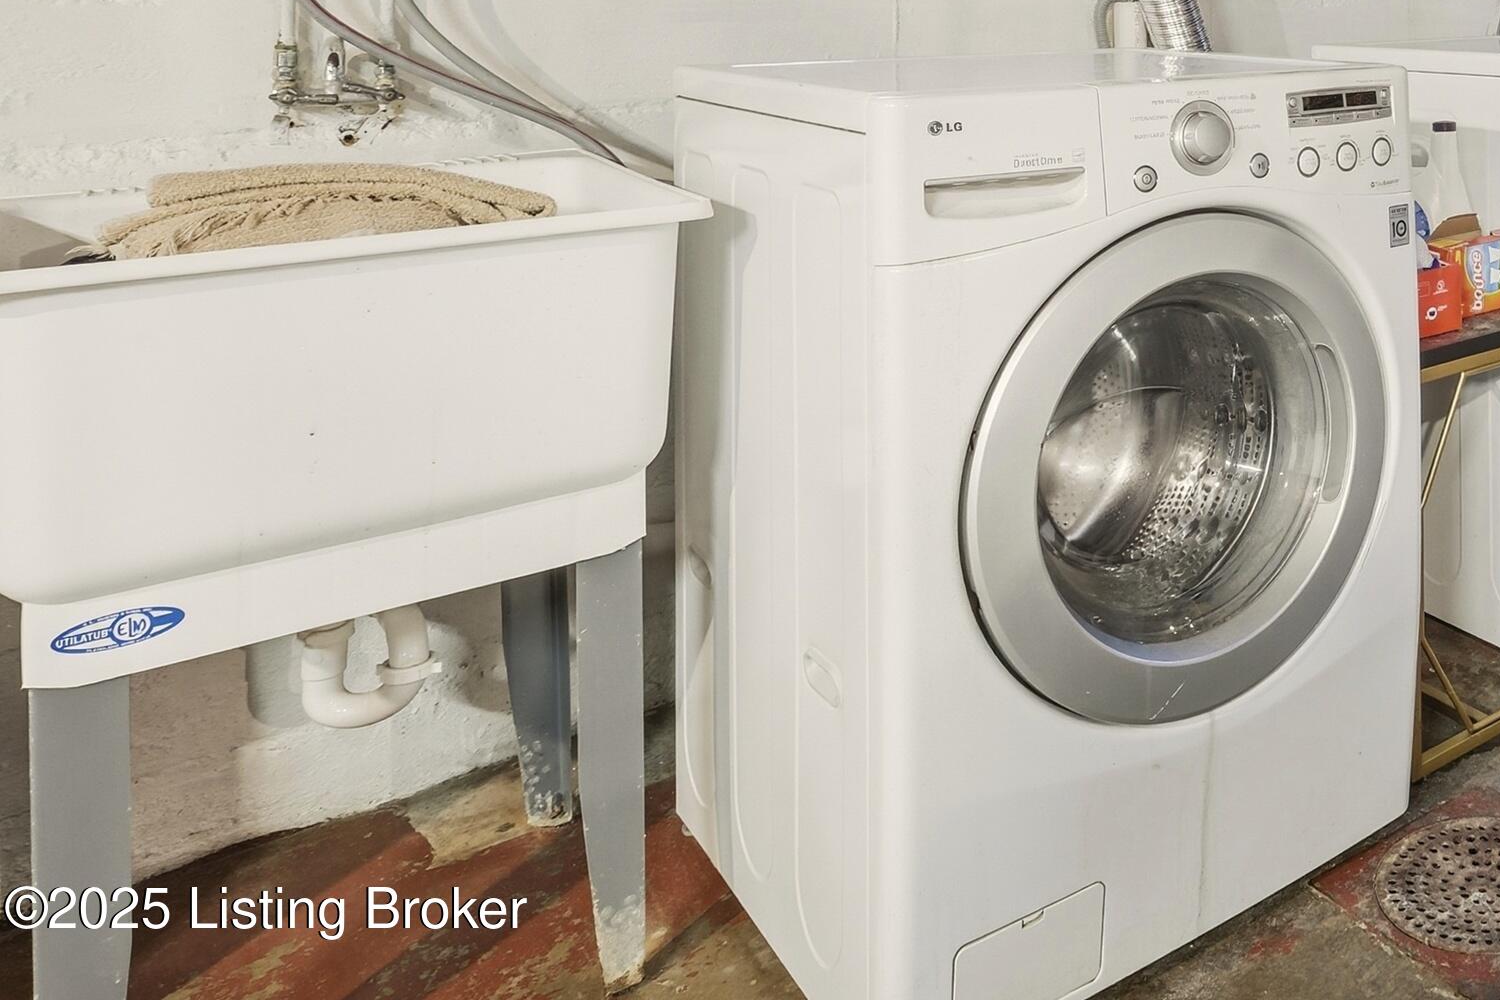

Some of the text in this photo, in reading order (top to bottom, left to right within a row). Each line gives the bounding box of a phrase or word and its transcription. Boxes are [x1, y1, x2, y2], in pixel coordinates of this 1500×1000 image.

[946, 121, 963, 133] LG
[1471, 250, 1484, 310] bounce
[55, 630, 109, 649] UTILATUB
